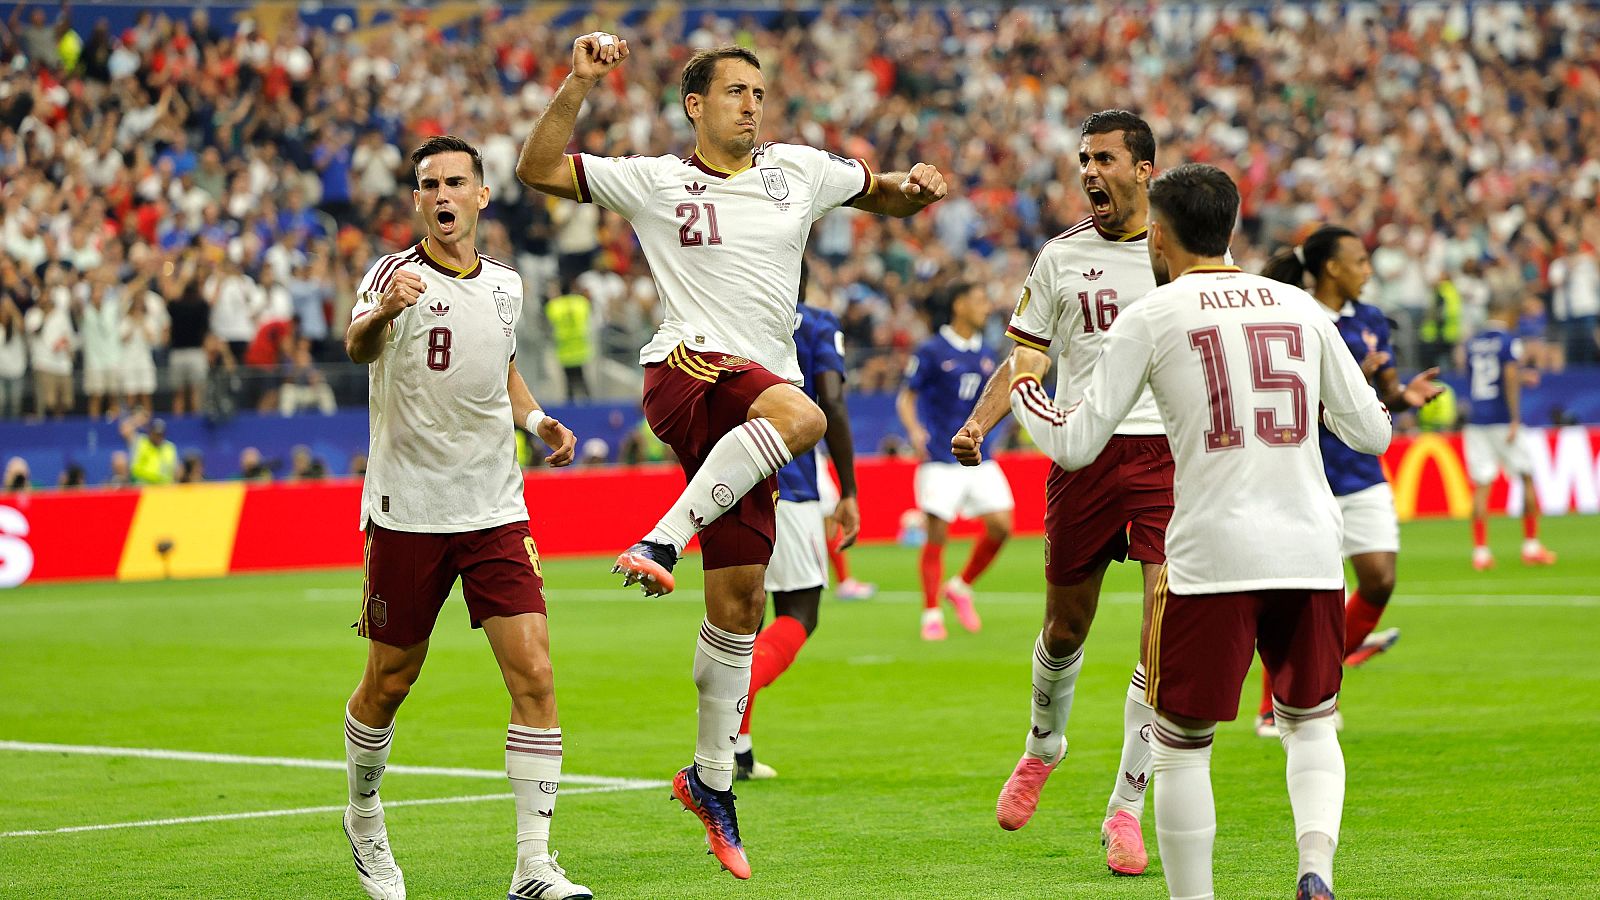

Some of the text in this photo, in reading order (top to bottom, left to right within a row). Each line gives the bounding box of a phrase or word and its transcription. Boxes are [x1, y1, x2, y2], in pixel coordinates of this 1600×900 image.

[675, 203, 722, 247] 21
[1077, 289, 1118, 333] 16
[1200, 288, 1281, 310] ALEX B.
[427, 327, 452, 371] 8
[1188, 322, 1309, 452] 15
[1471, 354, 1500, 400] 12
